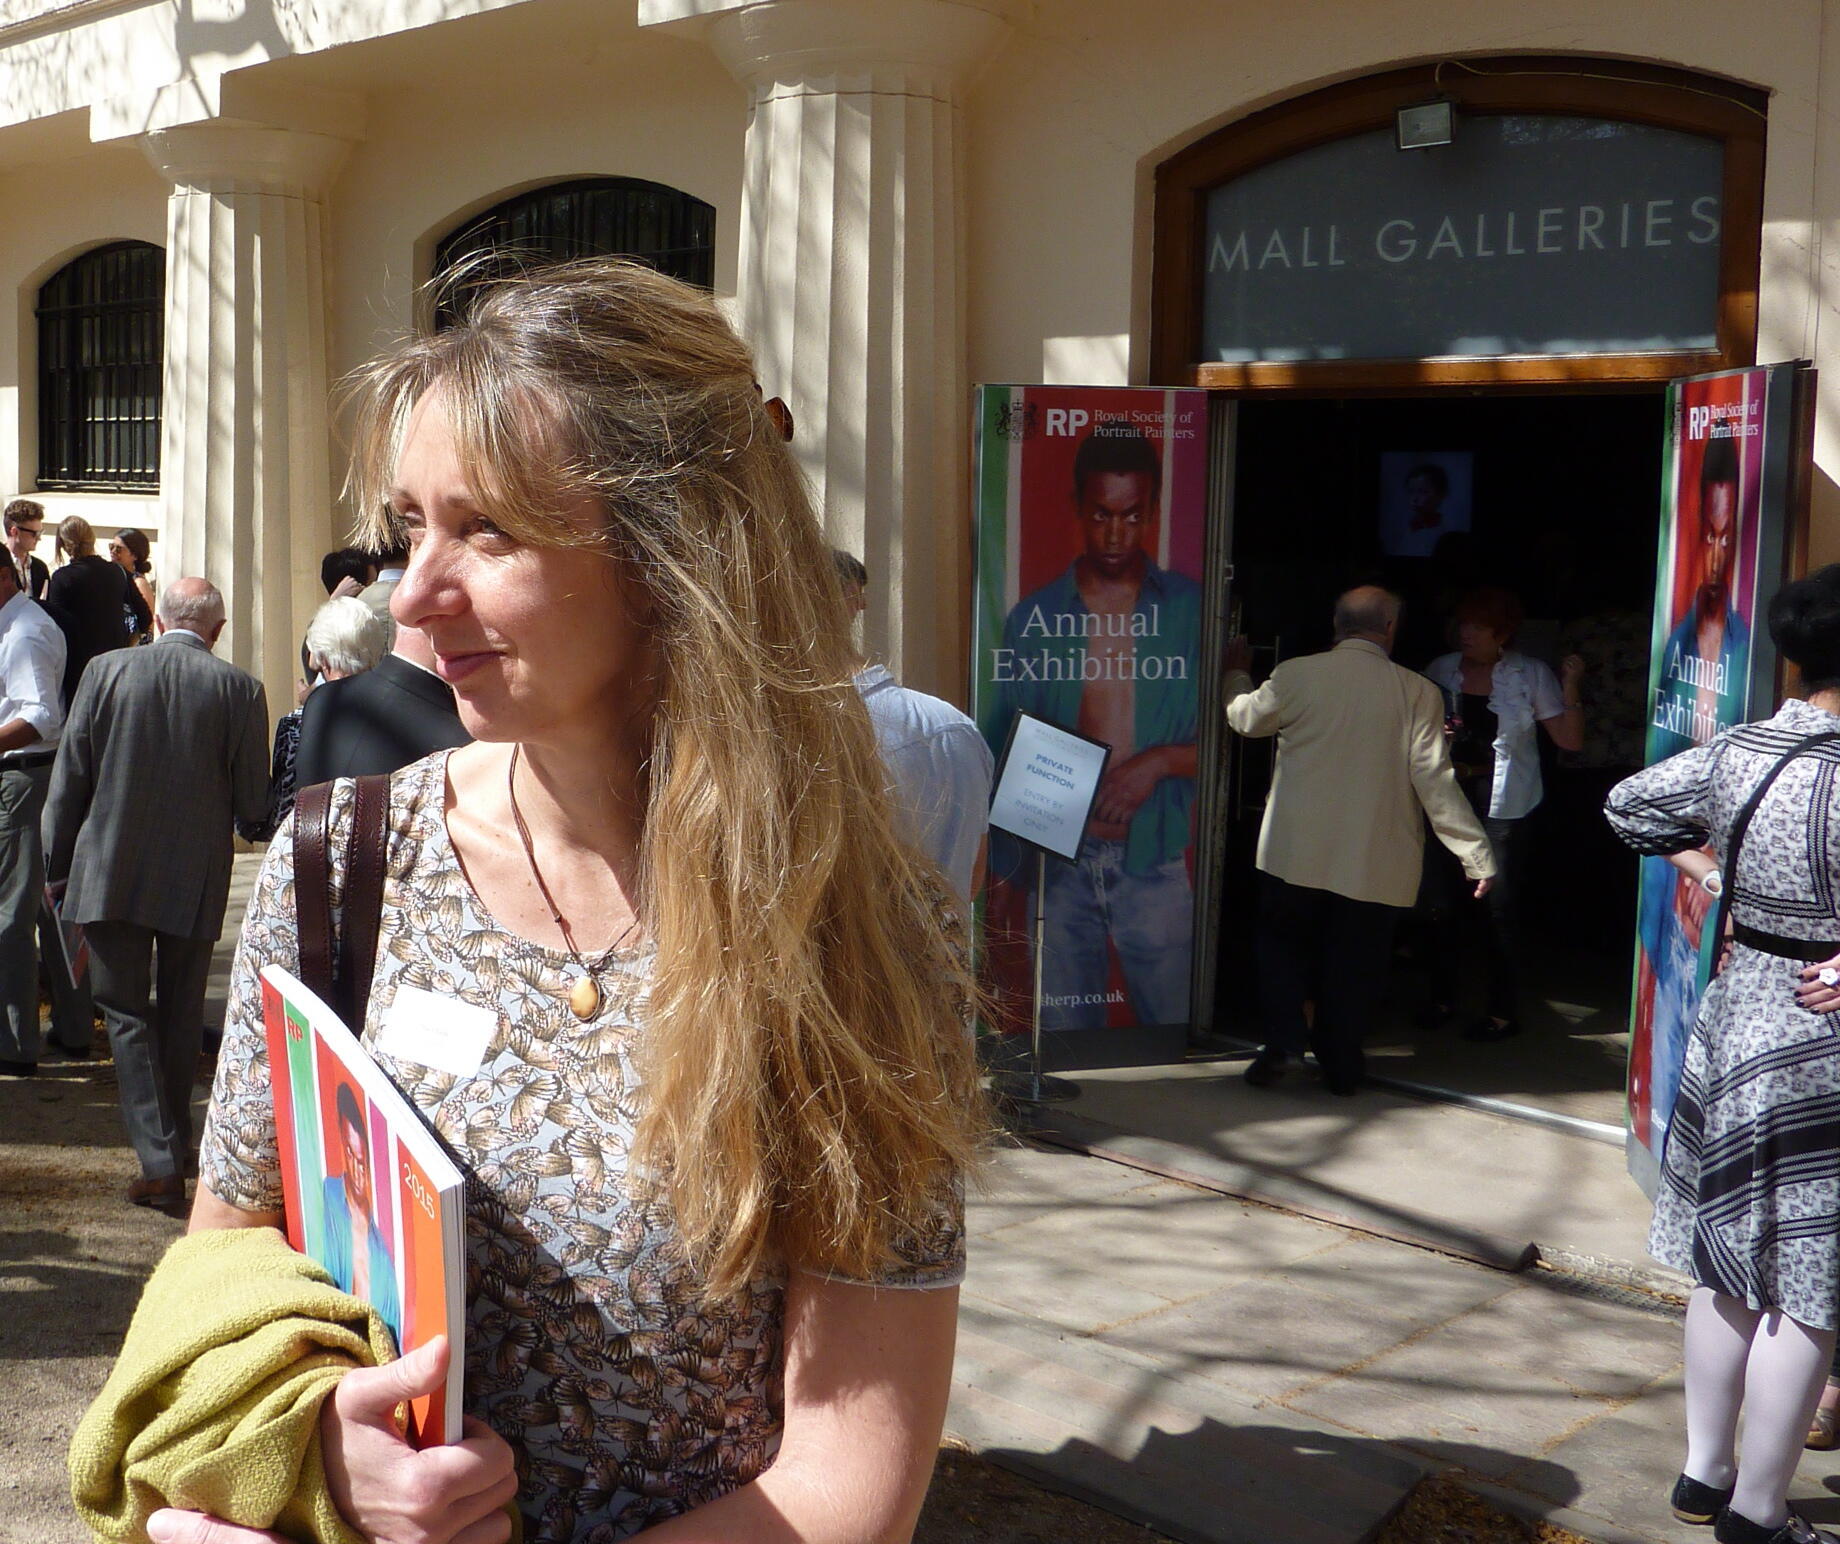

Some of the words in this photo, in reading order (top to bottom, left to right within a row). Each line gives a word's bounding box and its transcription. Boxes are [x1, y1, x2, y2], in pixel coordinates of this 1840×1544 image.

[1209, 225, 1345, 272] MALL
[1375, 196, 1720, 263] GALLERIES
[1046, 408, 1089, 437] RP
[1094, 409, 1128, 425] Royal
[1180, 411, 1194, 424] of
[1094, 425, 1140, 438] Portrait
[1689, 405, 1710, 440] RP
[1020, 604, 1160, 638] Annual
[989, 647, 1188, 682] Exhibition
[1668, 641, 1730, 696] Annual
[1652, 687, 1728, 743] Exhibitio
[1026, 764, 1075, 790] FUNCTION
[1035, 753, 1074, 775] PRIVATE
[287, 1015, 303, 1043] RP
[403, 1162, 435, 1220] 2015
